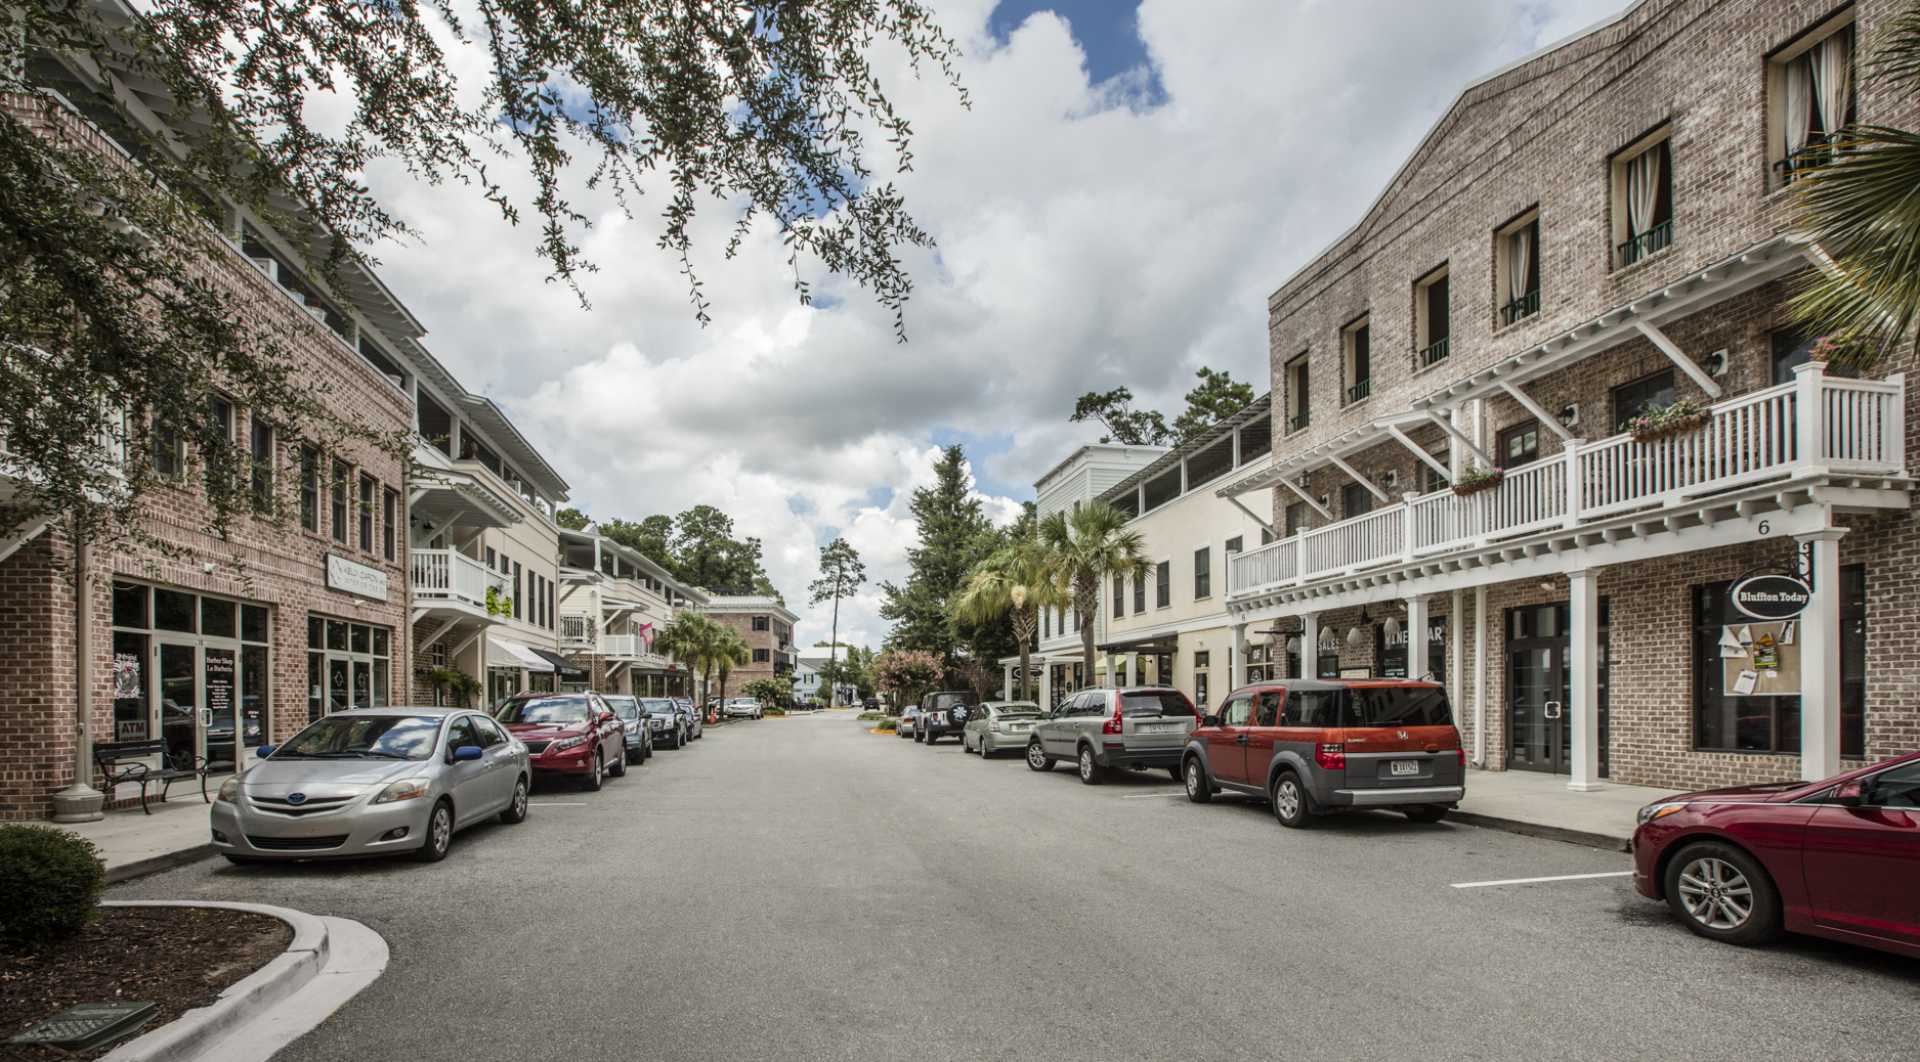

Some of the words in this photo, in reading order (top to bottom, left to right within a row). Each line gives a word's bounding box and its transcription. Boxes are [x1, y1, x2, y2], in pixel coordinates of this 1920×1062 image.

[1759, 519, 1770, 535] 6
[1740, 591, 1779, 602] Bluffton
[1779, 591, 1808, 604] Today
[1427, 626, 1443, 641] AR
[121, 722, 145, 734] ATM
